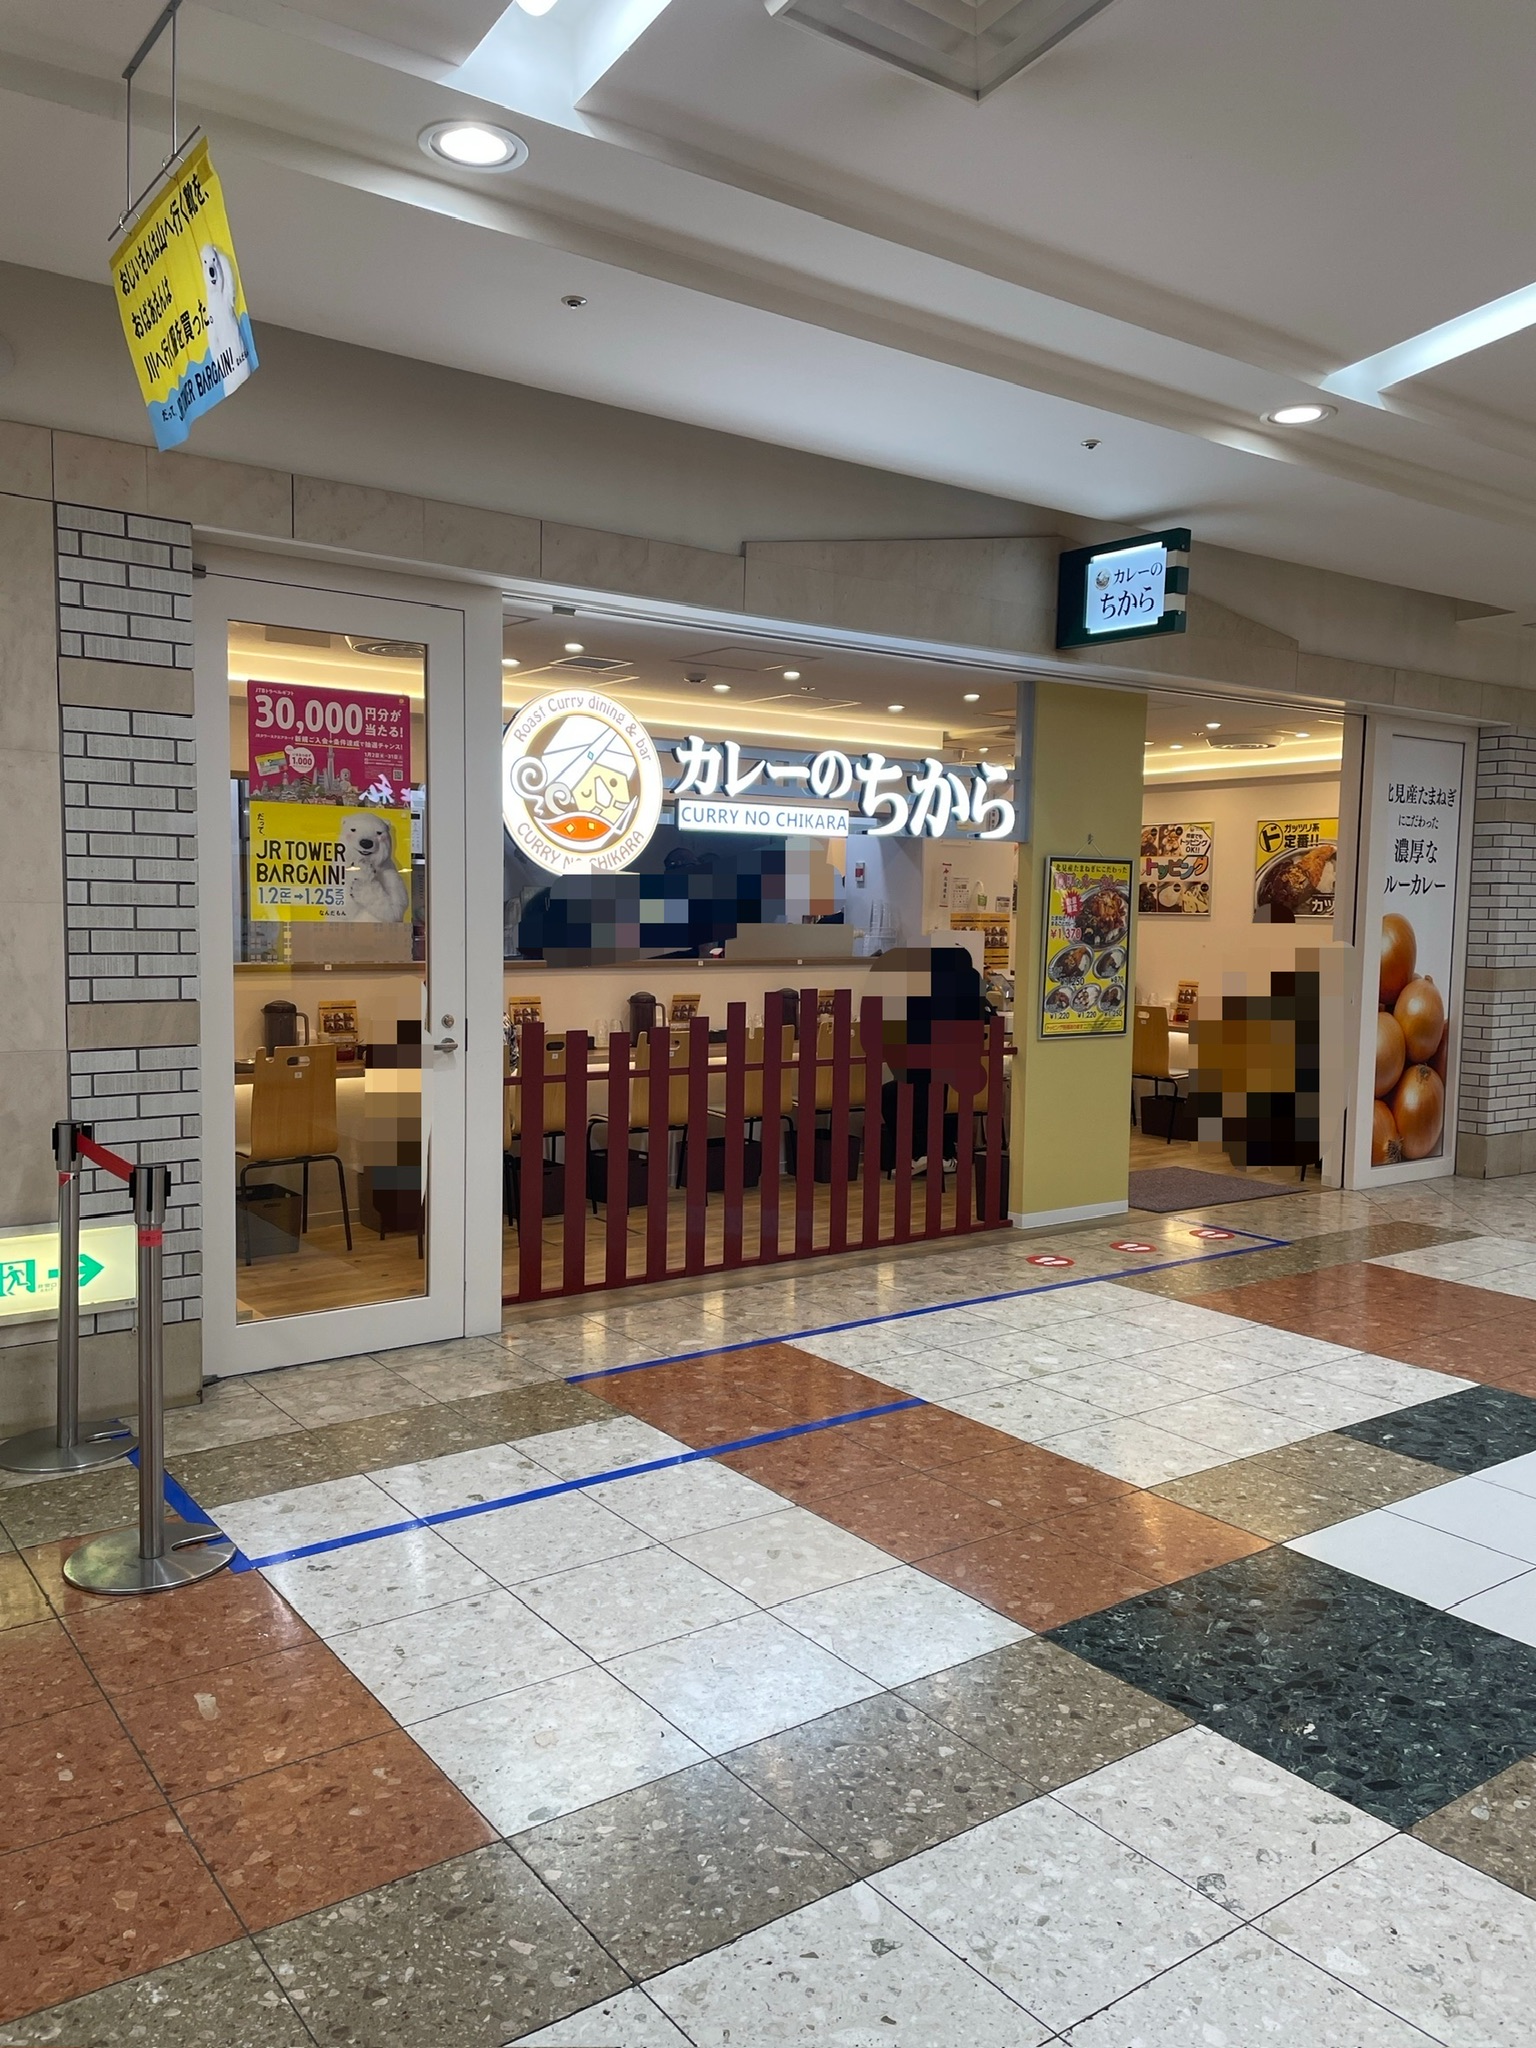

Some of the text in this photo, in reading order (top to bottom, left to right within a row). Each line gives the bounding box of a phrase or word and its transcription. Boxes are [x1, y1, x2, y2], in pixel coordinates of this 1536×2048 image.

[194, 346, 235, 398] BARGAIN!
[1113, 561, 1163, 585] カレーの
[1100, 586, 1155, 620] ちから
[254, 694, 402, 736] 30,000 円分が
[513, 696, 652, 762] Roast Curry dining & bar
[681, 806, 848, 831] CURRY NO CHIKARA
[1398, 814, 1439, 829] にこだわった
[256, 840, 346, 862] JR TOWER
[517, 822, 561, 864] CURRY
[1394, 838, 1438, 864] 濃厚な
[256, 862, 346, 886] BARGAIN!
[1145, 856, 1209, 880] トッピング
[258, 886, 345, 905] 1.2 FRI 1.25 SUN
[1383, 873, 1446, 896] ルーカレー
[319, 909, 347, 917] なんだもん
